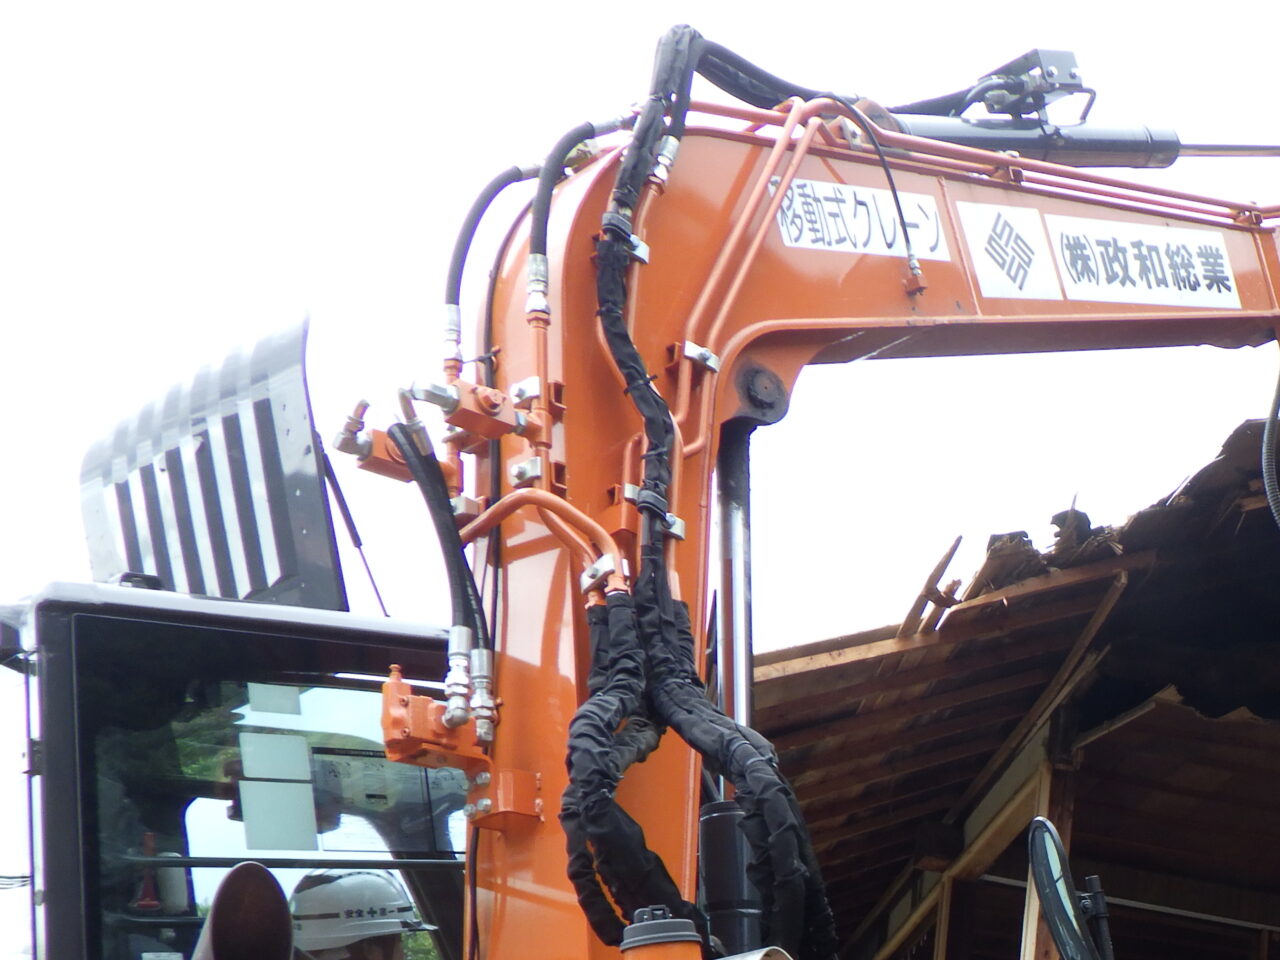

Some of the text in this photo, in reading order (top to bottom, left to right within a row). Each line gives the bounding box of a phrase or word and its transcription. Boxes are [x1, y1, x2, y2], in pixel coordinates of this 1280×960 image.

[770, 179, 939, 252] 移動式クレーン
